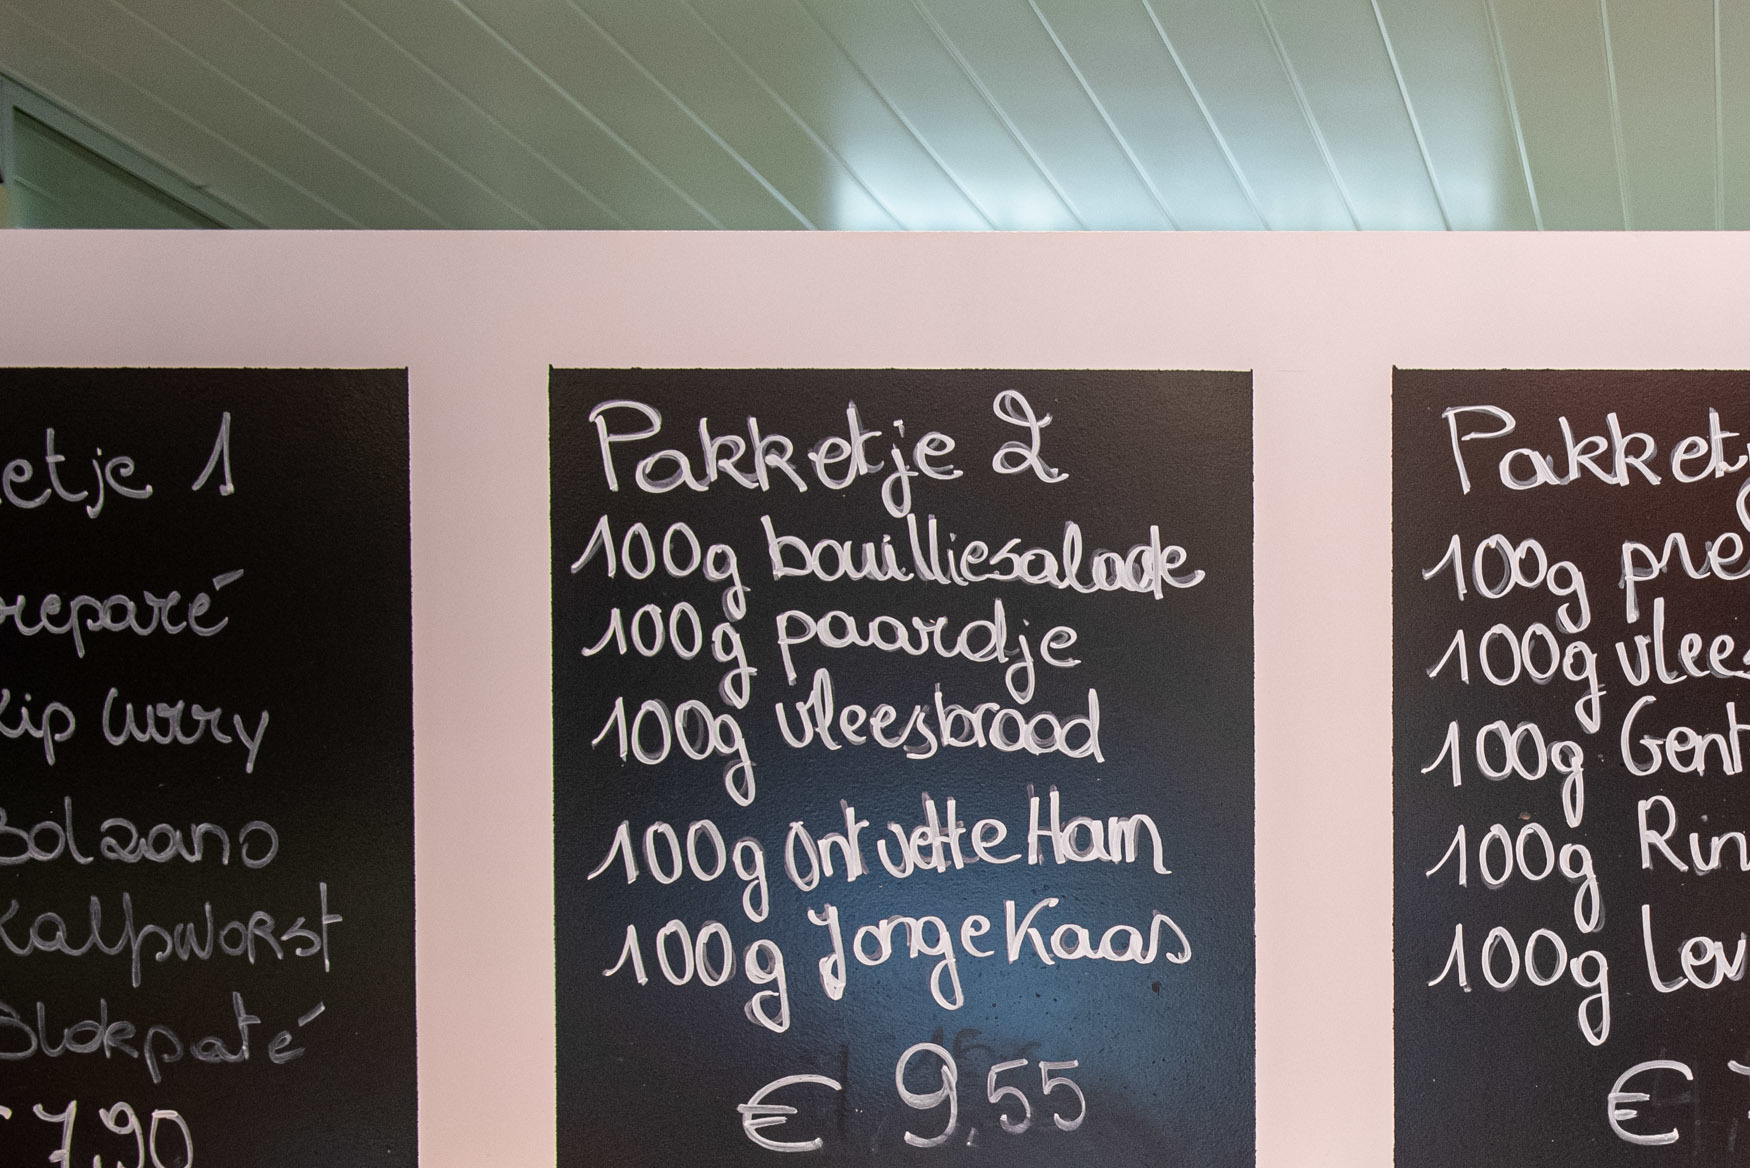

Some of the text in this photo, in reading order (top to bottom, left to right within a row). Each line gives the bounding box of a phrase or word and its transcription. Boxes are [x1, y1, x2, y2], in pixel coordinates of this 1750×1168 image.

[2, 411, 235, 518] etje 1
[589, 389, 1069, 517] Pakketje 2
[0, 569, 245, 659] reparé
[571, 515, 751, 620] 100g
[1422, 533, 1591, 633] 100g
[581, 597, 1081, 709] 100g paardje
[1426, 623, 1606, 734] 100g
[592, 696, 756, 802] 100g
[1420, 720, 1584, 827] 100g
[588, 819, 768, 923] 100g
[1026, 784, 1172, 874] Ham
[1425, 823, 1605, 933] 100g
[602, 919, 789, 1034] 100g
[1427, 923, 1609, 1047] 100g
[737, 1074, 842, 1152] €
[1607, 1059, 1693, 1146] €
